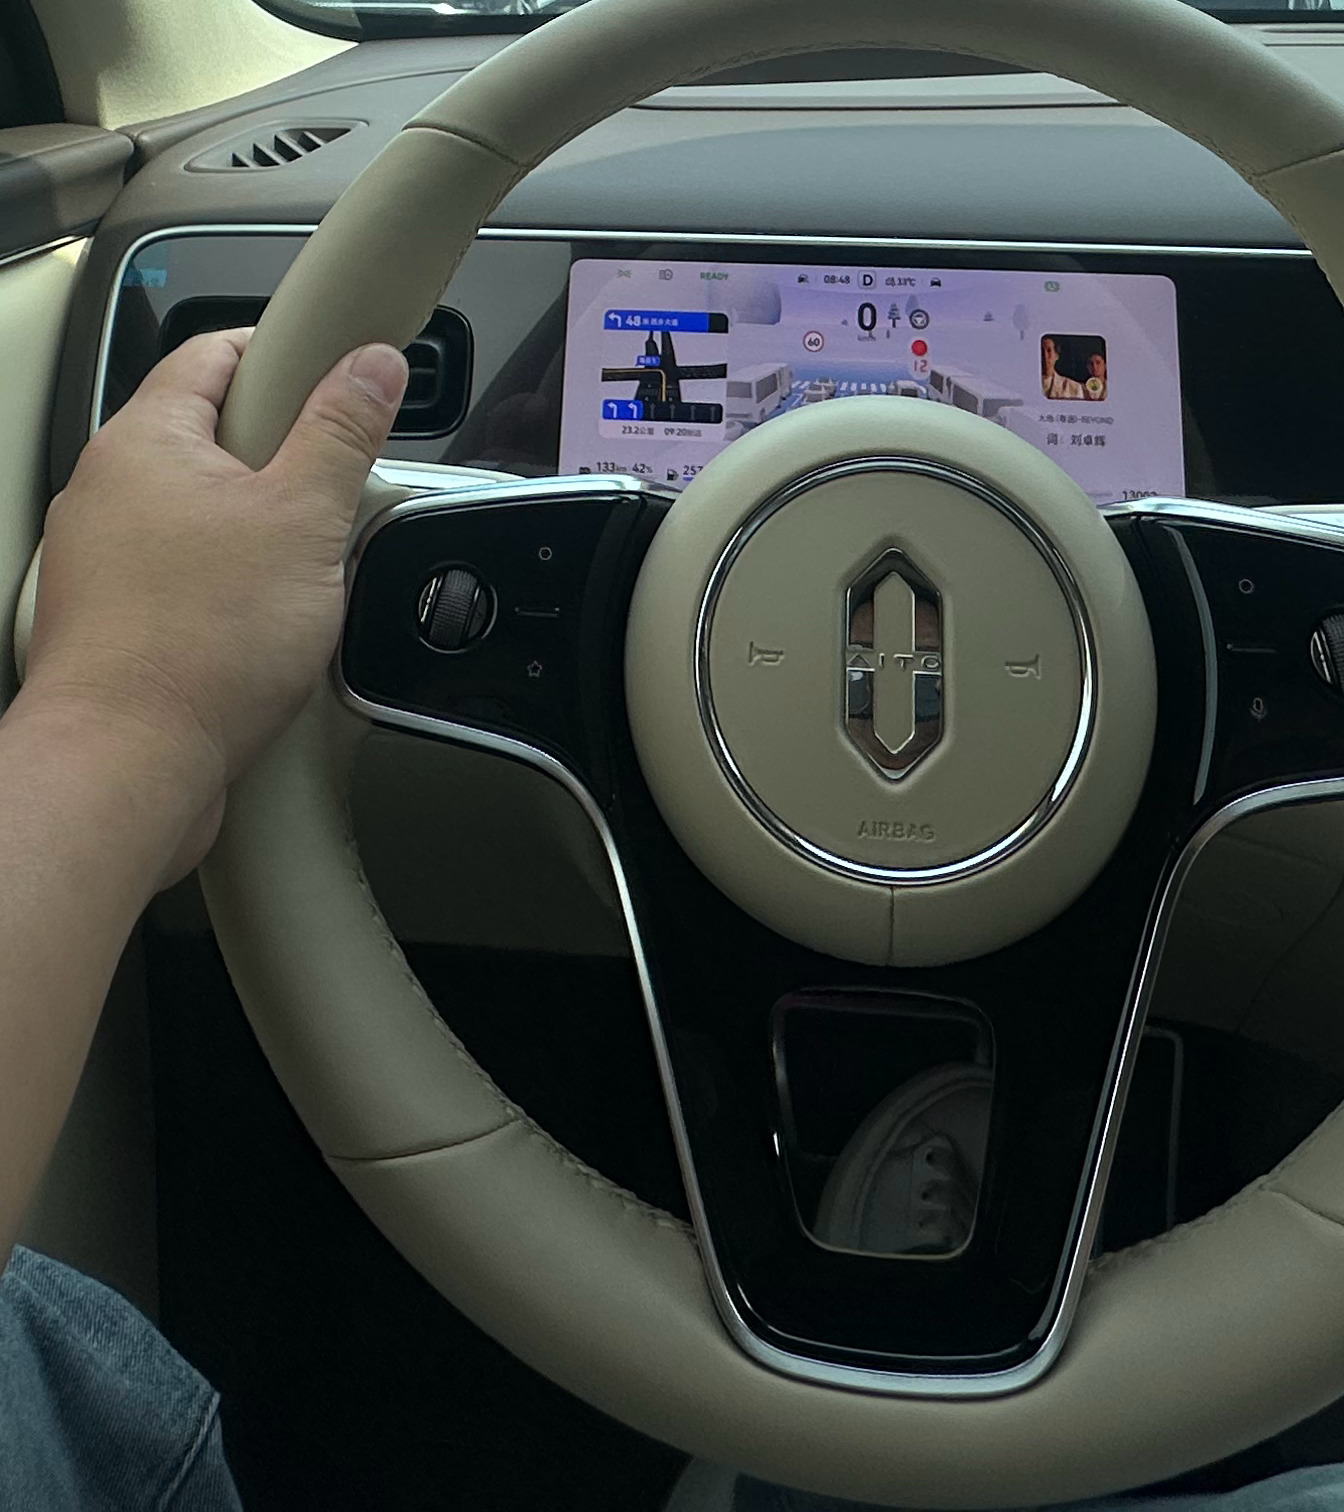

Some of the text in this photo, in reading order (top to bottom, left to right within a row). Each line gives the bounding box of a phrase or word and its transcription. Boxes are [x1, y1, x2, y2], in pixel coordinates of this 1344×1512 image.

[700, 272, 729, 281] READY
[862, 274, 873, 287] D
[857, 302, 877, 331] 0
[807, 337, 820, 347] 60
[913, 359, 928, 372] 12
[857, 819, 937, 842] AIRBAG
